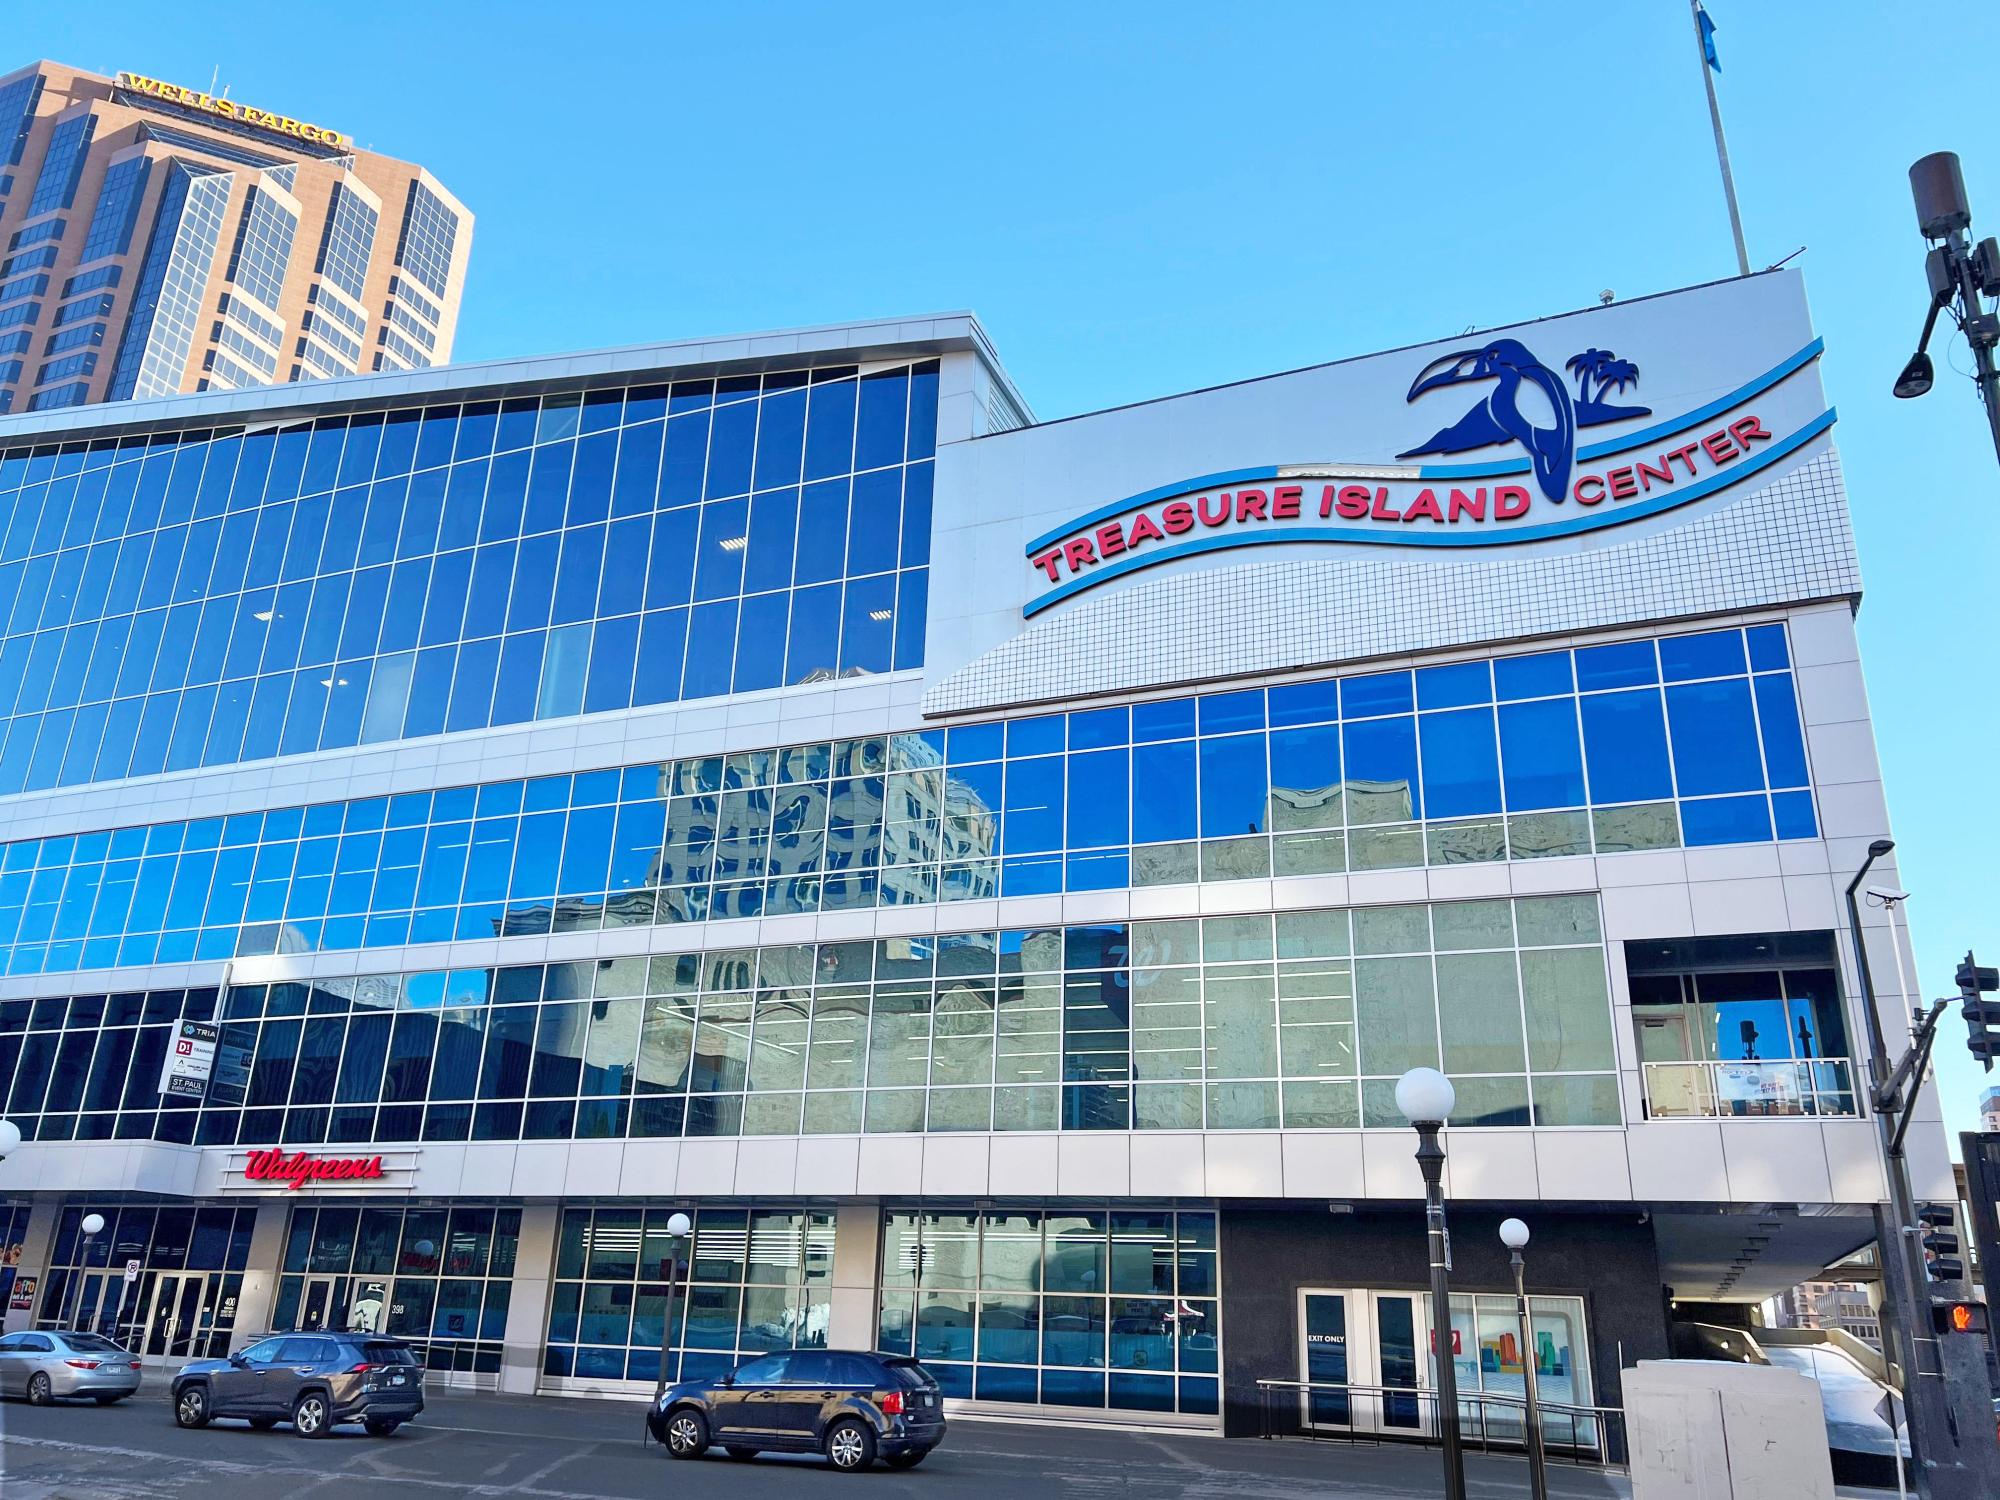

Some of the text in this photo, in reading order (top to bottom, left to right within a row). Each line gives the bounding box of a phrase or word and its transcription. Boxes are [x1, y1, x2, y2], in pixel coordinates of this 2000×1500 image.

[126, 72, 343, 146] WELLS FARGO
[1032, 414, 1772, 583] TREASURE ISLAND CENTER
[196, 1028, 216, 1038] TRIA
[185, 1080, 202, 1090] PAUL
[244, 1147, 384, 1190] Walgreens
[15, 1280, 35, 1294] afro
[224, 1297, 236, 1306] 400
